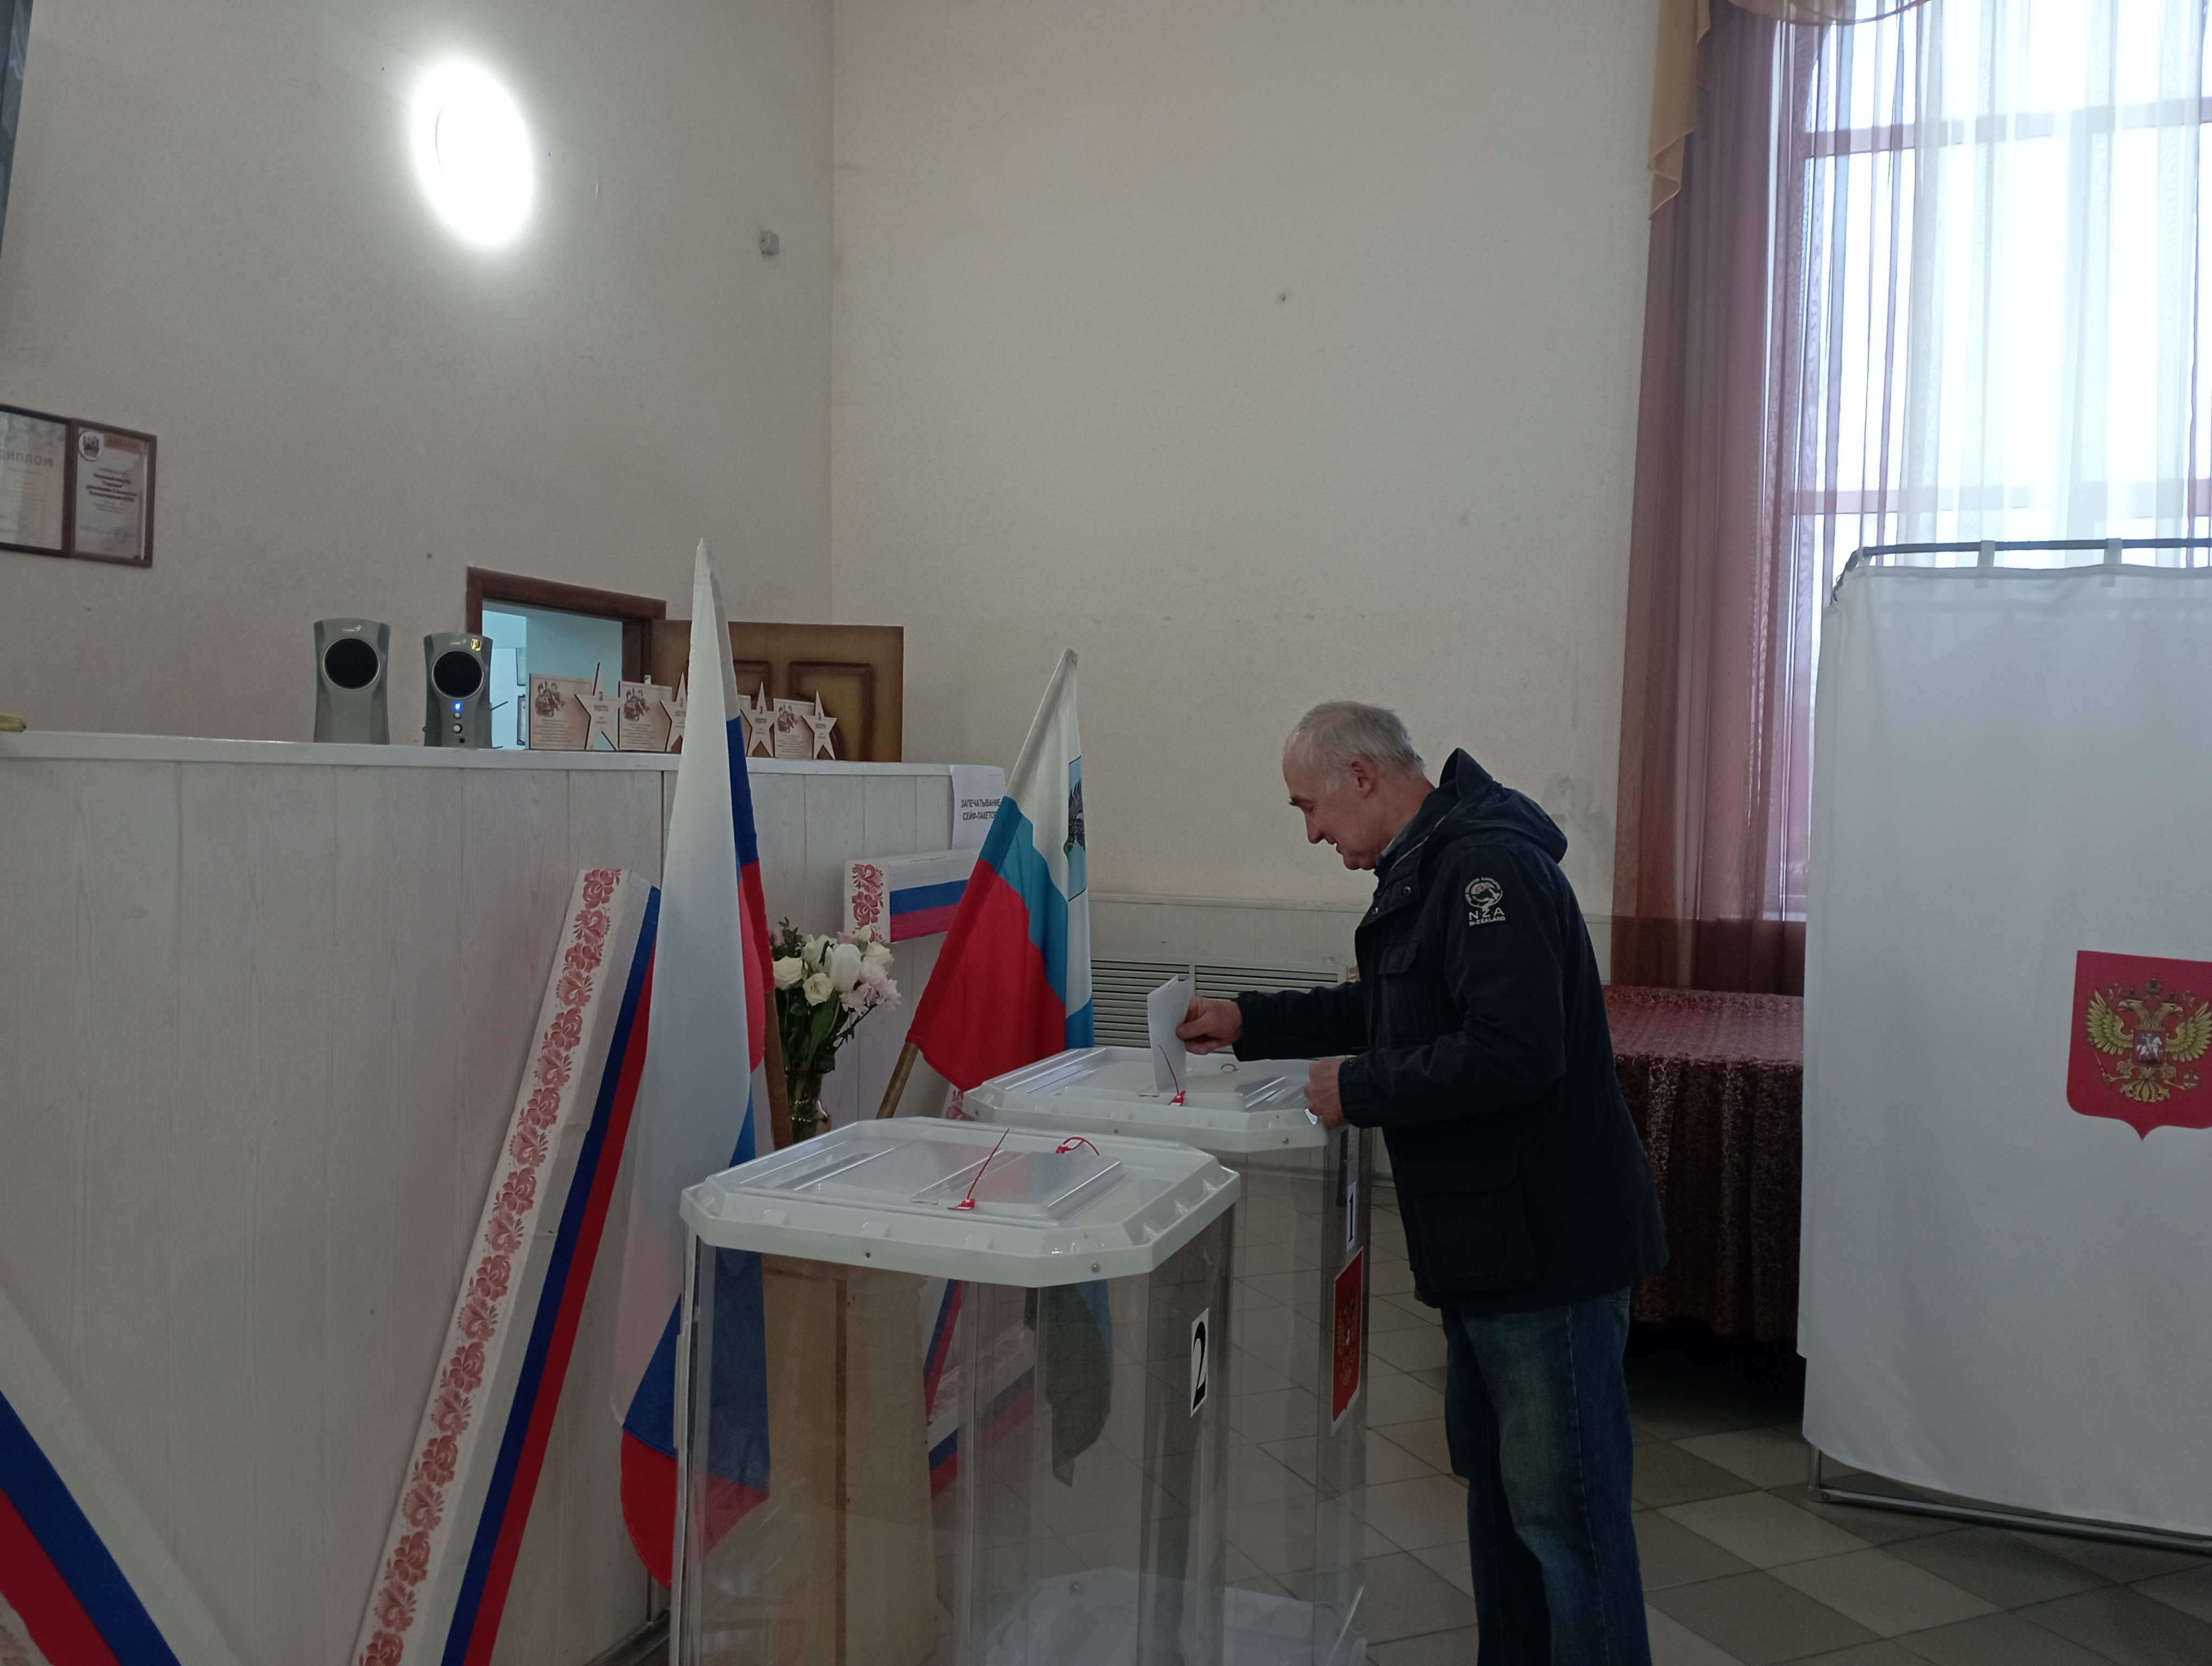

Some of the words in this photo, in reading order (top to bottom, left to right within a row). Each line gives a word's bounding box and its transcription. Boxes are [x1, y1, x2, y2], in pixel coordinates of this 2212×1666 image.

[599, 691, 603, 701] 2
[759, 706, 763, 715] 3
[961, 798, 1001, 808] ЗАПЕЧАТЫВАНИЕ
[1469, 916, 1506, 926] N-ZEALAND
[1348, 1192, 1354, 1243] 1
[1192, 1321, 1206, 1411] 2
